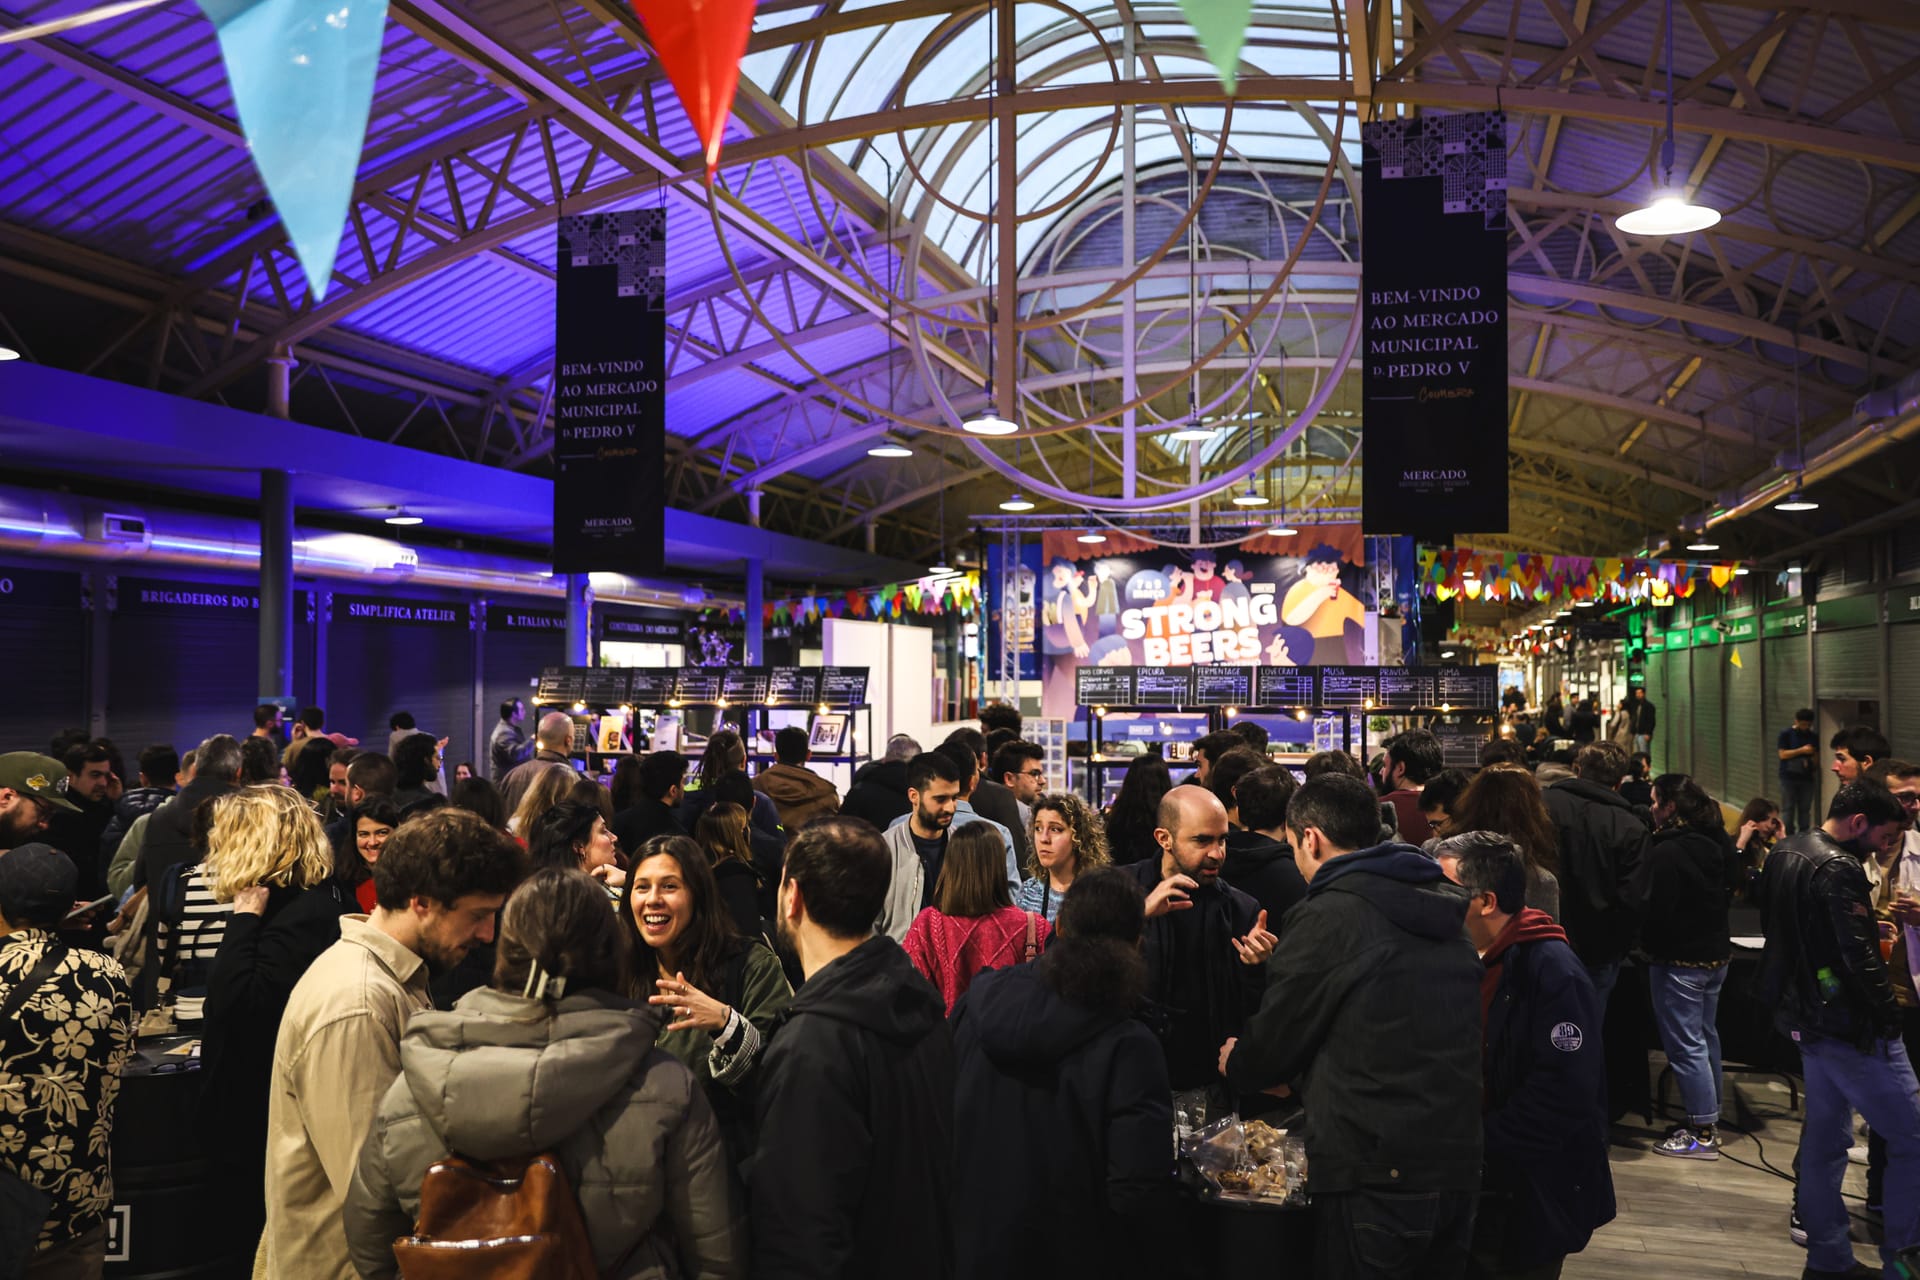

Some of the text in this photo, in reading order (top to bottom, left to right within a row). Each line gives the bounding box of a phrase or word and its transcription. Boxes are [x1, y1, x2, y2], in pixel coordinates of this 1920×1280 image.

[1371, 286, 1480, 305] BEM-VINDO
[1371, 310, 1498, 329] AO MERCADO
[1371, 336, 1479, 354] MUNICIPAL
[562, 359, 644, 376] BEM-VINDO
[1388, 361, 1451, 378] PEDRO
[1459, 360, 1471, 375] V
[561, 380, 657, 397] AO MERCADO
[561, 402, 642, 418] MUNICIPAL
[574, 425, 623, 439] PEDRO
[627, 424, 636, 436] V
[1403, 469, 1467, 480] MERCADO
[584, 516, 632, 527] MERCADO
[141, 589, 228, 607] BRIGADEIROS
[232, 595, 249, 608] DO
[349, 602, 455, 622] SIMPLIFICA ATELIER
[1121, 594, 1278, 640] STRONG
[518, 615, 550, 628] ITALIAN
[1143, 627, 1262, 667] BEERS
[1137, 668, 1165, 676] EPICURA
[1261, 667, 1299, 676] LOVECRAFT
[1324, 667, 1344, 676] MUSA
